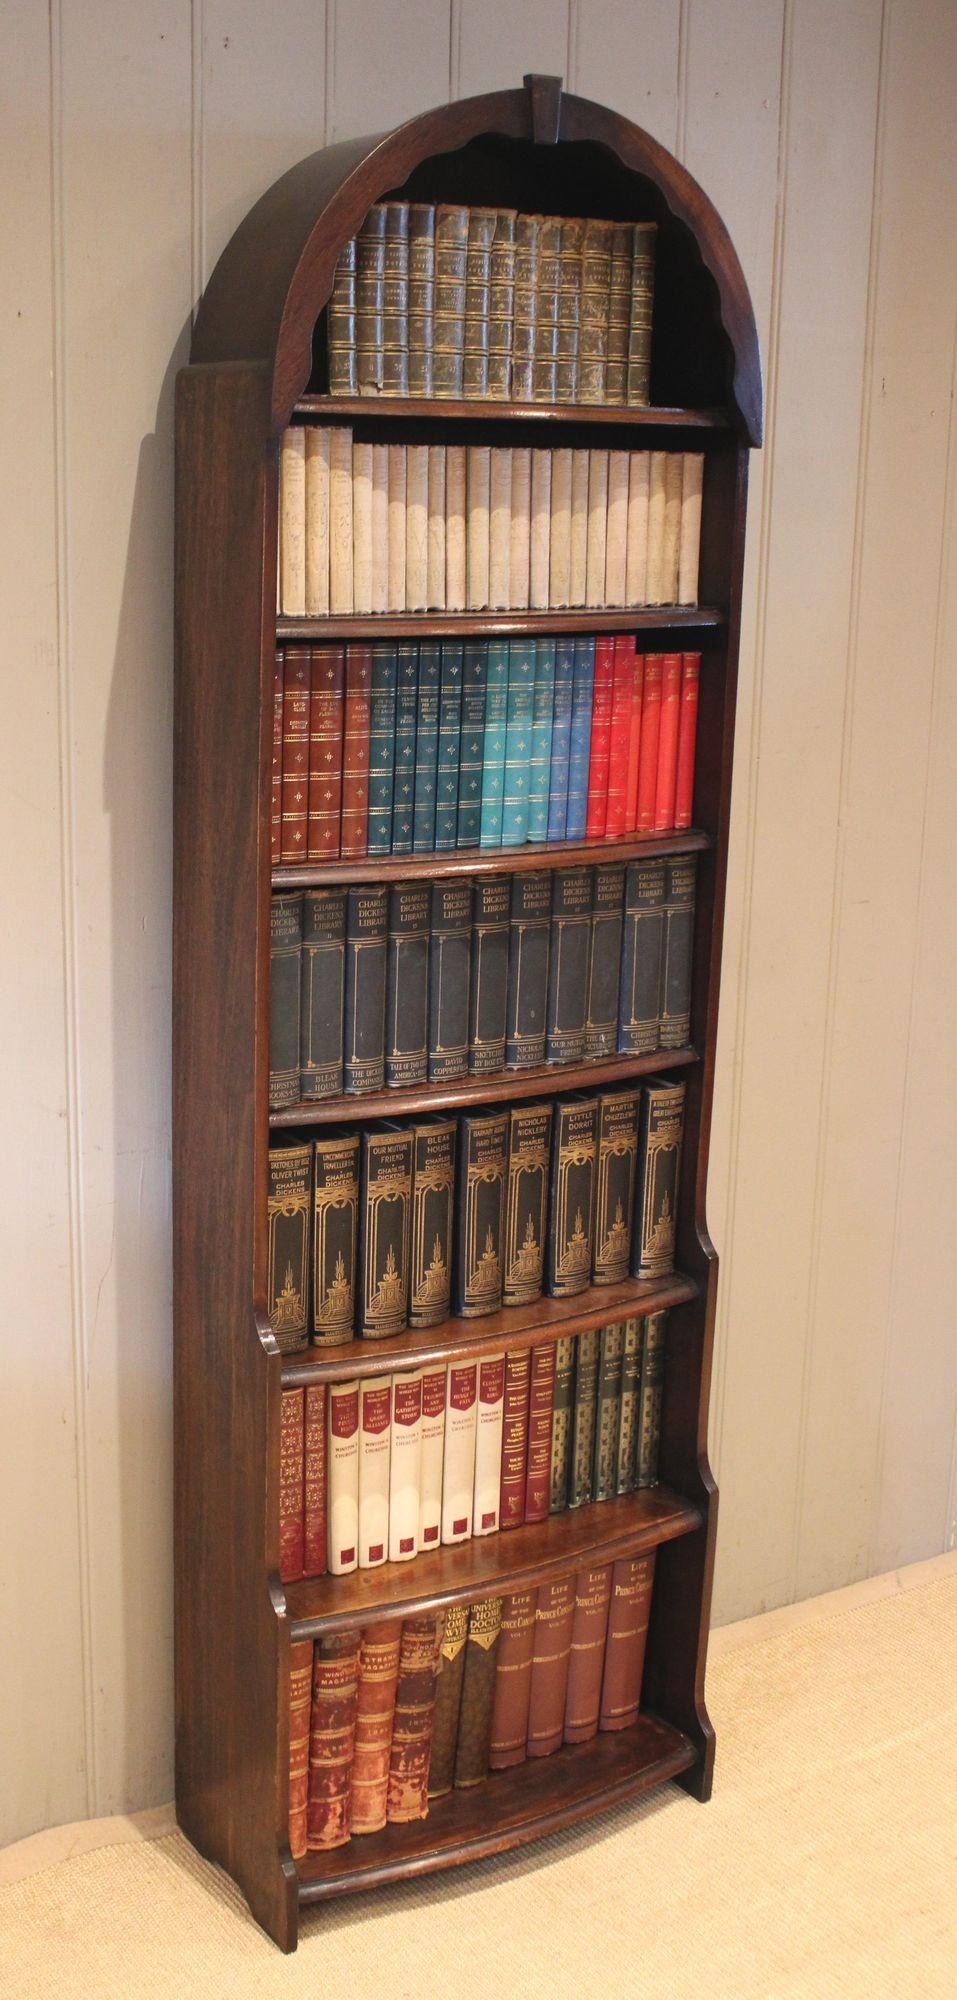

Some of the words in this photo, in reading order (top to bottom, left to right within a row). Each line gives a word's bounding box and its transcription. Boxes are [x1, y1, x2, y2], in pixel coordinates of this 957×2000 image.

[400, 894, 428, 904] CHARLES
[313, 903, 344, 912] CHARLES
[400, 902, 429, 912] DICKENS
[314, 912, 344, 922] DICKENS
[400, 911, 427, 921] LIBRARY
[314, 921, 343, 931] LIBRARY
[551, 1040, 565, 1049] OUR
[445, 1058, 463, 1066] DAVID
[474, 1059, 483, 1067] BY
[315, 1073, 338, 1083] BLEAK
[352, 1070, 364, 1078] THE
[314, 1082, 338, 1092] HOUSE
[610, 1103, 634, 1113] MARTIN
[569, 1111, 593, 1121] LITTLE
[518, 1116, 547, 1127] NICHOLAS
[568, 1120, 593, 1130] DORRIT
[609, 1122, 634, 1131] CHARLES
[518, 1126, 547, 1136] NICKLEBY
[568, 1131, 593, 1140] CHARLES
[609, 1129, 634, 1137] DICKENS
[427, 1135, 450, 1144] BLEAK
[519, 1138, 545, 1147] CHARLES
[568, 1138, 593, 1146] DICKENS
[372, 1146, 386, 1155] OUR
[388, 1143, 408, 1153] MUTUAL
[427, 1145, 450, 1154] HOUSE
[519, 1144, 545, 1152] DICKENS
[381, 1154, 404, 1163] FRIEND
[425, 1155, 450, 1165] CHARLES
[271, 1160, 294, 1170] SKETCHES
[377, 1165, 406, 1175] CHARLES
[425, 1162, 450, 1171] DICKENS
[271, 1170, 292, 1180] OLIVER
[294, 1168, 309, 1177] TWIST
[325, 1171, 353, 1182] CHARLES
[377, 1172, 406, 1181] DICKENS
[276, 1181, 305, 1190] CHARLES
[325, 1179, 354, 1188] DICKENS
[276, 1187, 305, 1196] DICKENS
[631, 1561, 648, 1572] LIFE
[589, 1573, 606, 1582] LIFE
[551, 1585, 568, 1595] LIFE
[615, 1584, 635, 1597] PRINCE
[512, 1596, 530, 1605] LIFE
[476, 1609, 499, 1620] HOME
[536, 1608, 557, 1620] PRINCE
[447, 1619, 466, 1630] OME
